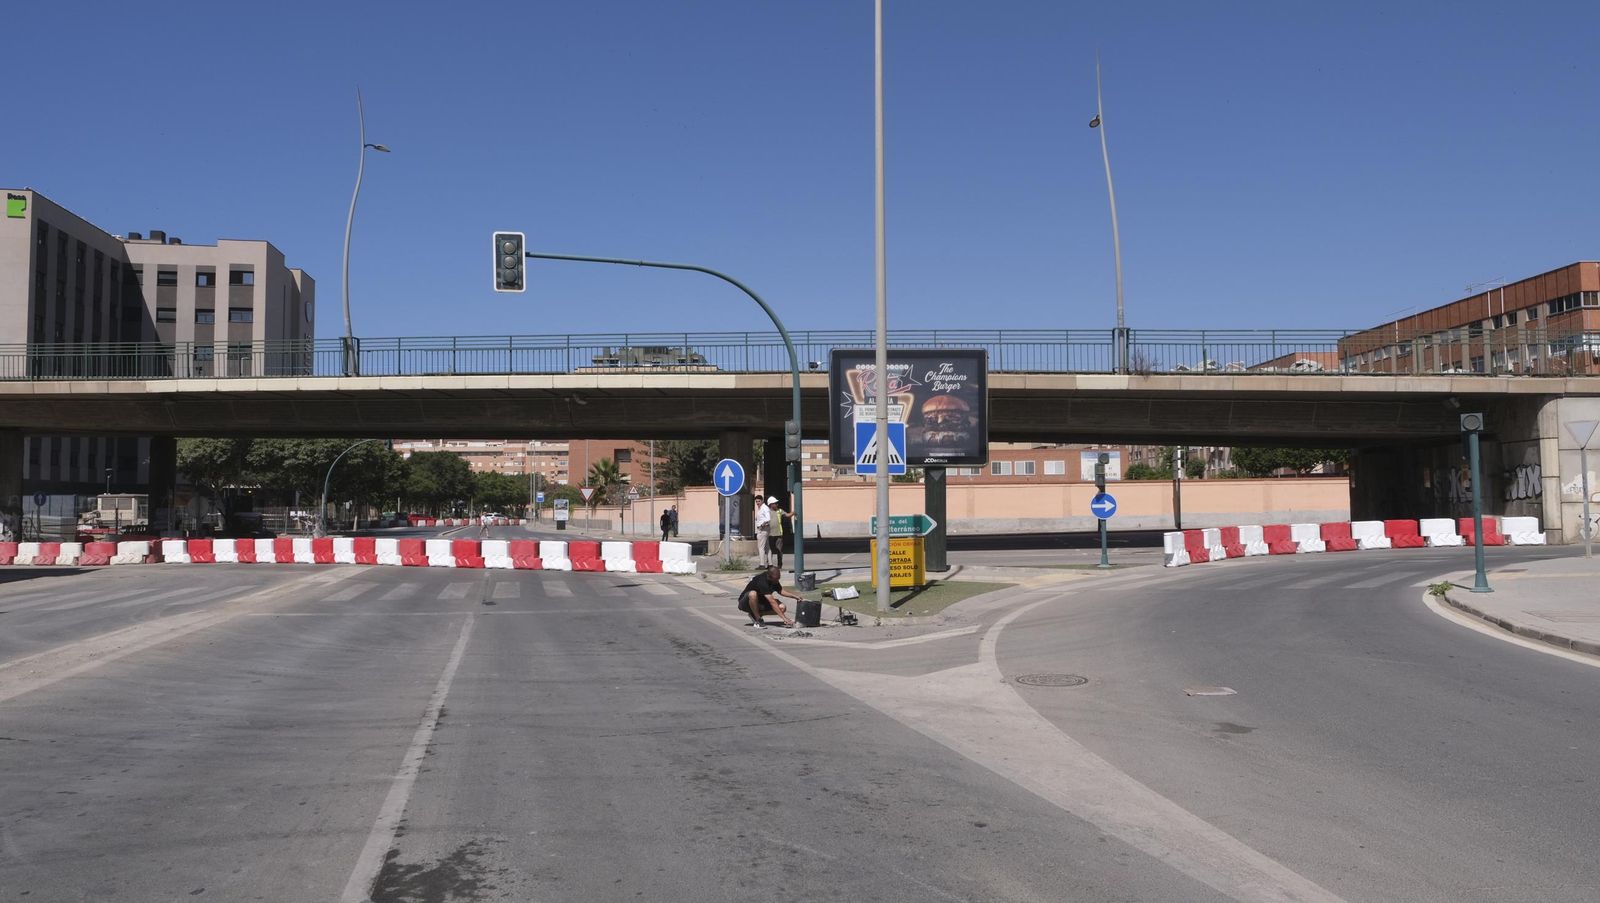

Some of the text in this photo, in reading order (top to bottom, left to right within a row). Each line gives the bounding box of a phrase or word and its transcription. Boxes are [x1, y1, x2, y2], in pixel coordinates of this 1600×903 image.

[939, 363, 954, 375] The
[924, 370, 968, 383] Champions
[931, 380, 961, 393] Burger
